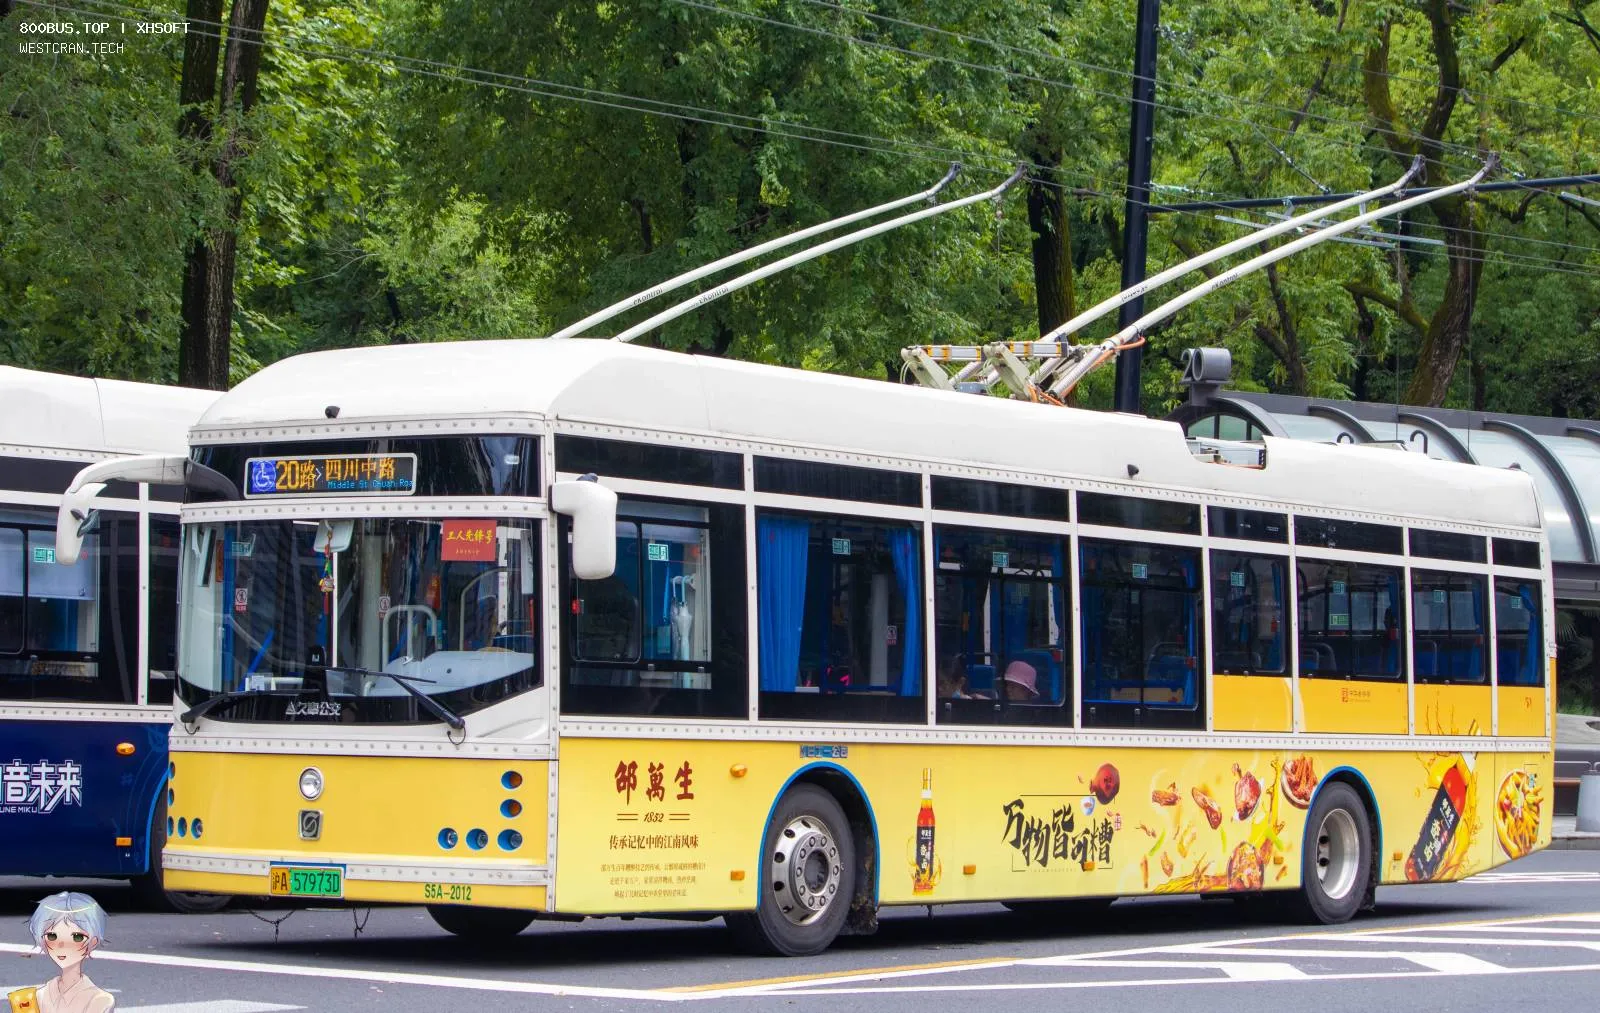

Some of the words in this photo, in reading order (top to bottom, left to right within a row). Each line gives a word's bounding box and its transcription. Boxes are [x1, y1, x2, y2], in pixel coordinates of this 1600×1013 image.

[275, 460, 316, 490] 20路
[325, 457, 396, 481] 四川中路
[327, 479, 356, 490] Middle
[0, 759, 82, 814] 音未来
[643, 811, 665, 823] 1852
[608, 834, 699, 850] 传承记忆中的江南风味
[1001, 798, 1115, 872] 万物皆可糟
[424, 883, 472, 901] S5A-2012
